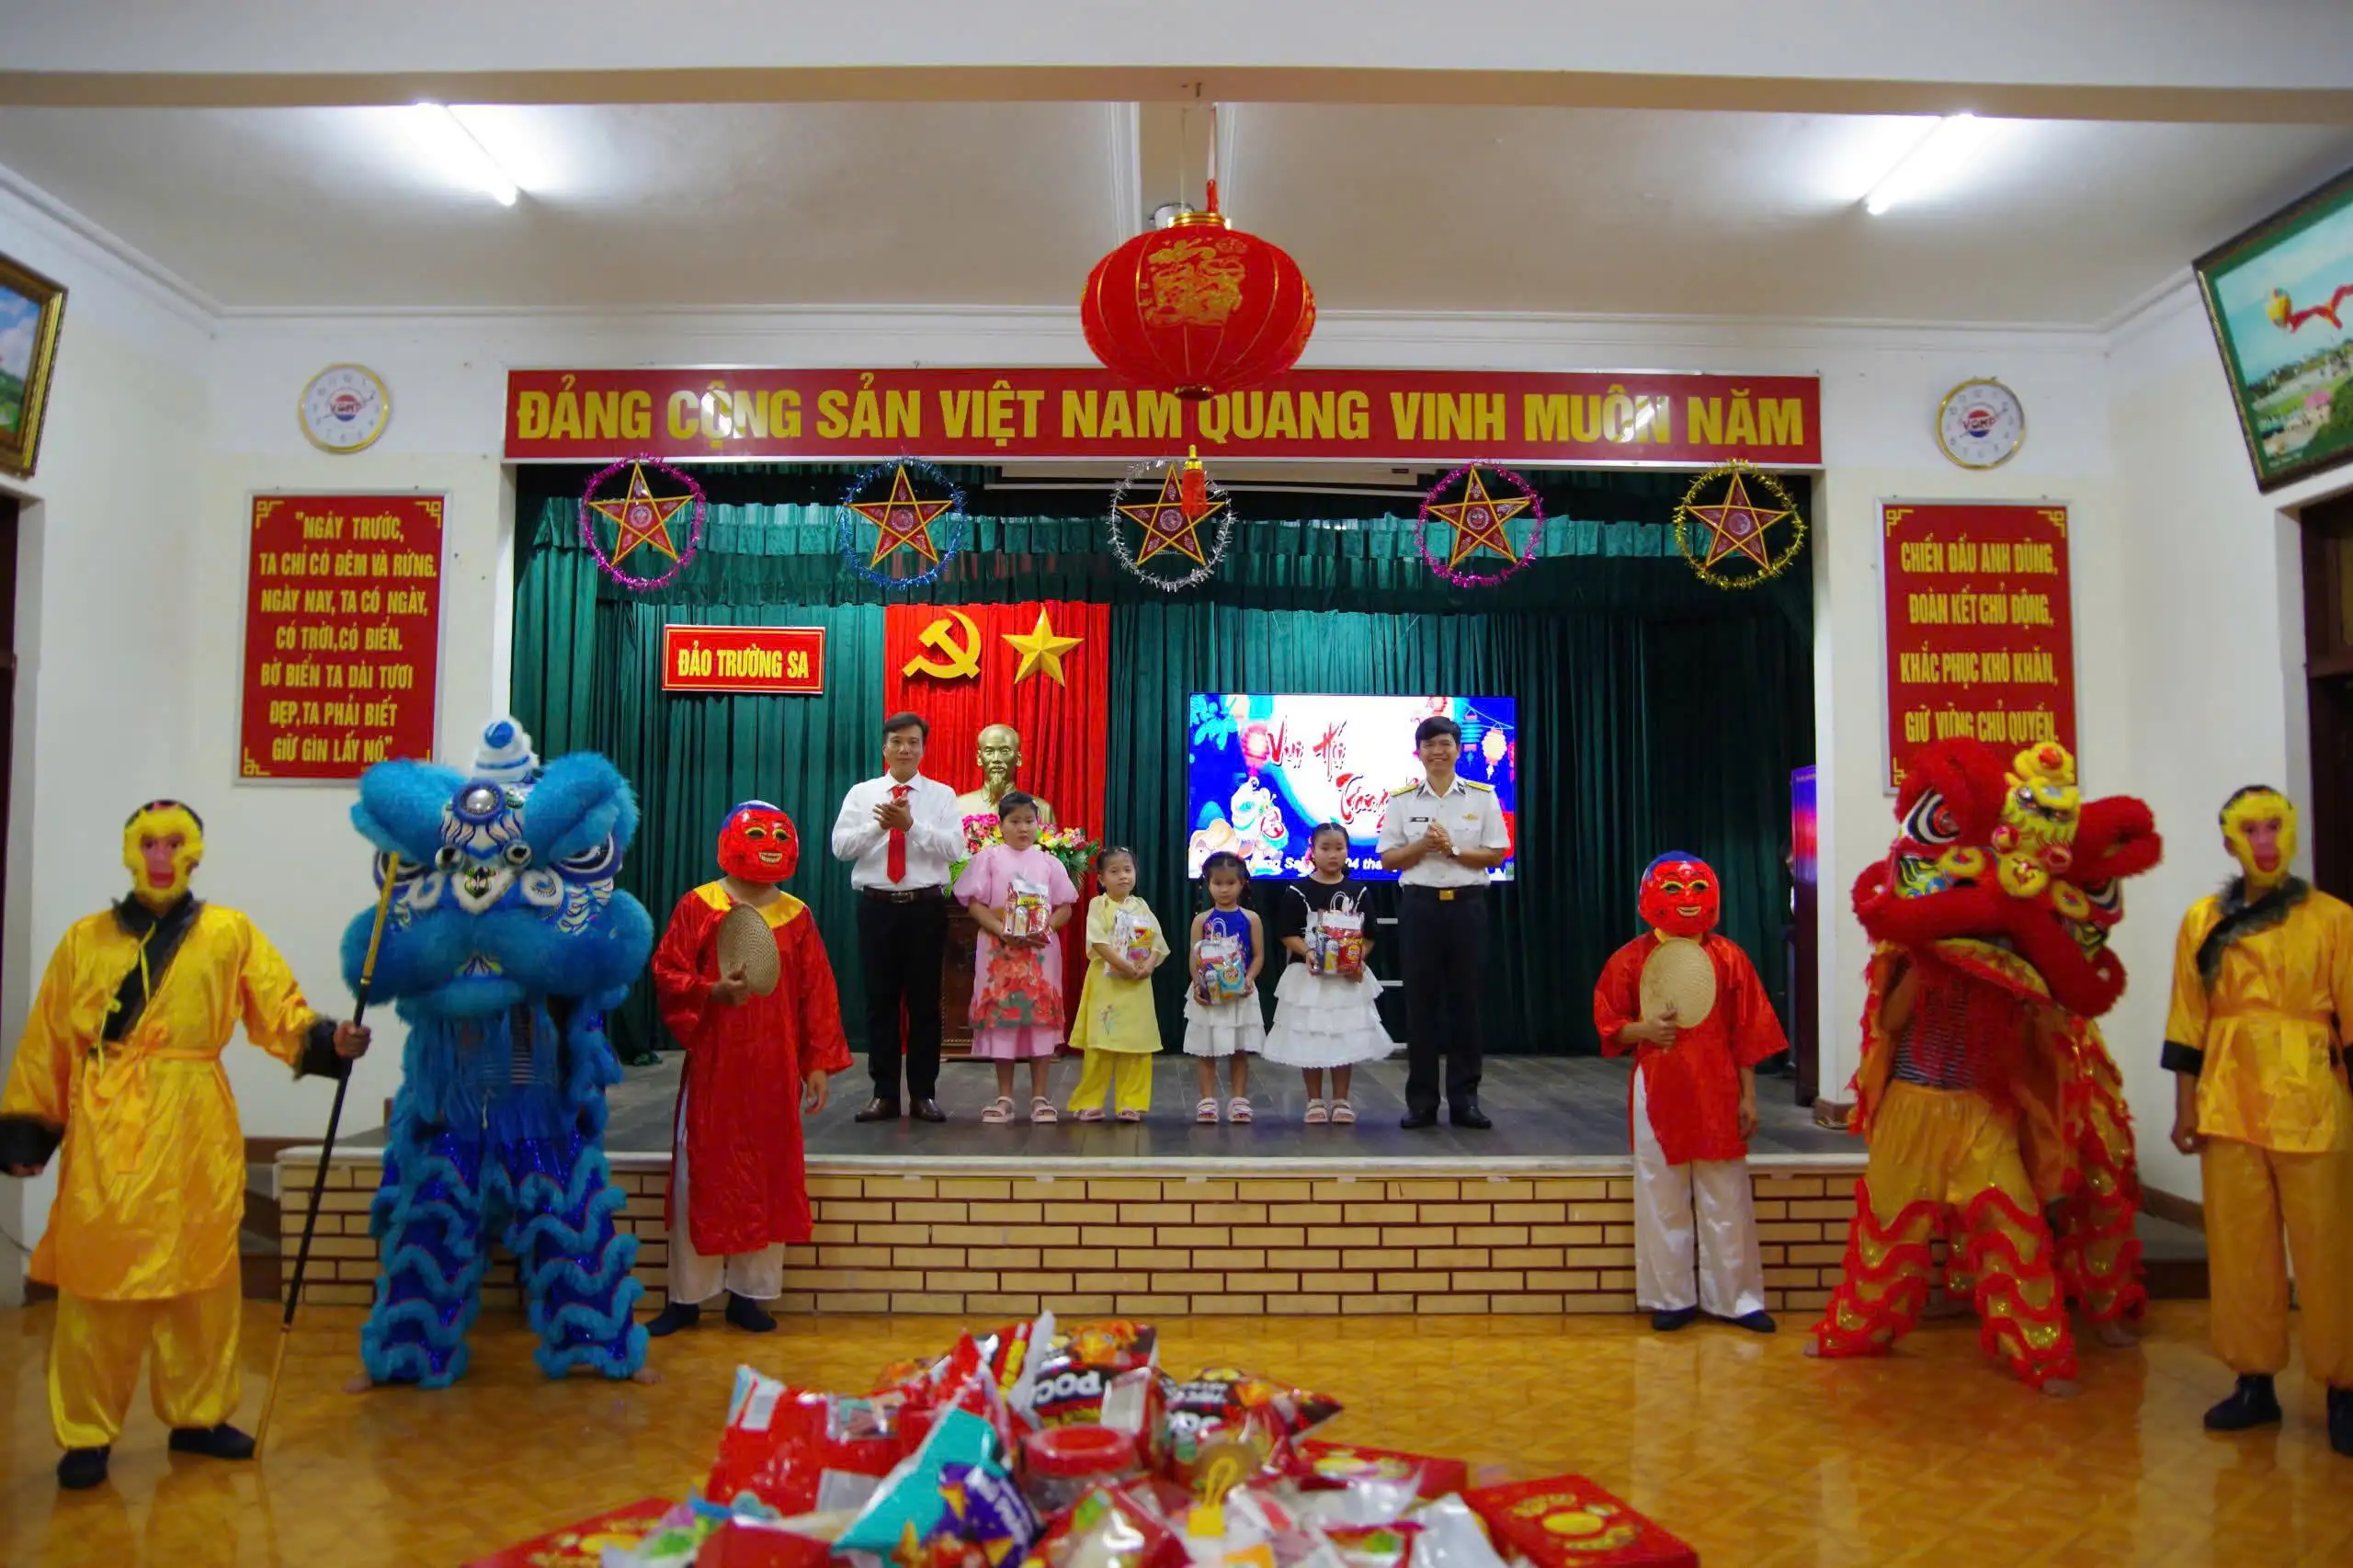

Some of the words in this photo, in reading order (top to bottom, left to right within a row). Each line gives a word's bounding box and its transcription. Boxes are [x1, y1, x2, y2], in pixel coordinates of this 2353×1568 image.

[517, 374, 652, 439] ĐẢNG
[667, 380, 801, 449] CỘNG
[816, 372, 920, 438] SẢN
[939, 380, 1044, 446] VIỆT
[1062, 390, 1182, 438] NAM
[1199, 391, 1370, 444] QUANG
[1390, 392, 1506, 442] VINH
[1524, 383, 1671, 443] MUÔN
[1688, 388, 1803, 446] NĂM
[259, 553, 277, 576] TA
[281, 544, 306, 576] CHỈ
[310, 549, 330, 576] CÓ
[335, 549, 367, 576] ĐÊM
[371, 549, 388, 576] VÀ
[1901, 532, 1944, 573] CHIẾN
[1981, 543, 2010, 573] ANH
[261, 584, 300, 613] NGÀY
[304, 590, 335, 615] NAY,
[340, 590, 357, 613] TA
[360, 585, 381, 613] CÓ
[1908, 585, 1948, 624] ĐOÀN
[1951, 584, 1977, 624] KẾT
[1979, 581, 2007, 624] CHỦ
[276, 619, 296, 650] CÓ
[260, 656, 282, 687] BỜ
[285, 653, 320, 687] BIỂN
[326, 665, 343, 687] TA
[348, 659, 373, 687] DÀI
[379, 664, 413, 689] TƯƠI
[677, 640, 712, 677] ĐẢO
[716, 643, 783, 678] TRƯỜNG
[787, 651, 809, 678] SA
[1900, 640, 1939, 683] KHẮC
[1941, 652, 1979, 690] PHỤC
[1981, 646, 2010, 683] KHÓ
[324, 693, 359, 726] PHẢI
[364, 695, 397, 727] BIẾT
[1904, 704, 1930, 743] GIỮ
[1977, 699, 2006, 743] CHỦ
[272, 733, 299, 762] GIỮ
[301, 734, 328, 762] GÌN
[333, 730, 359, 762] LẤY
